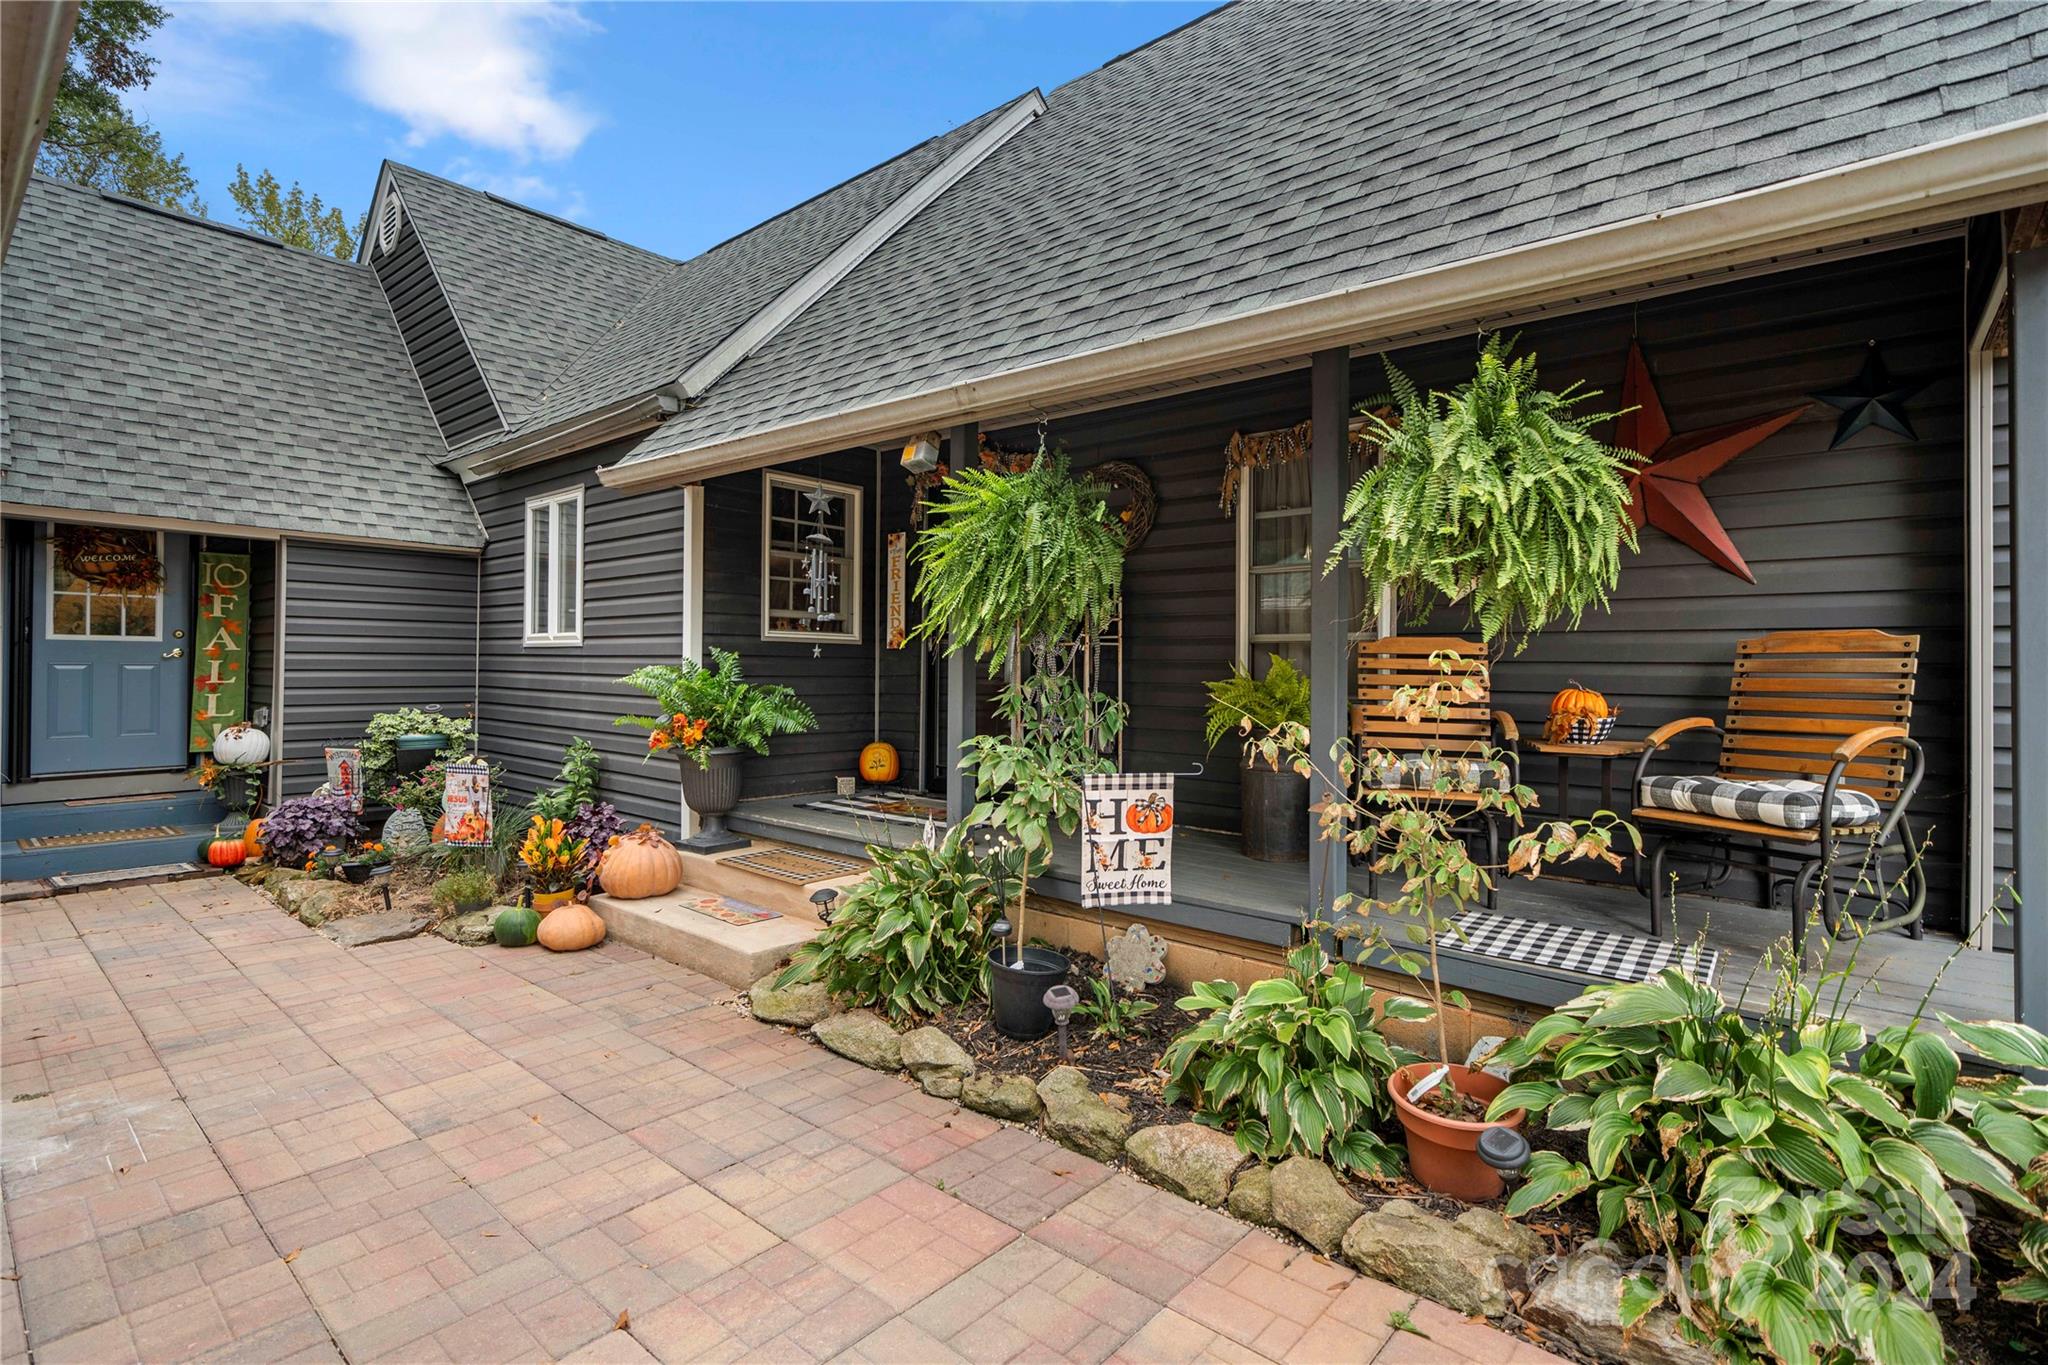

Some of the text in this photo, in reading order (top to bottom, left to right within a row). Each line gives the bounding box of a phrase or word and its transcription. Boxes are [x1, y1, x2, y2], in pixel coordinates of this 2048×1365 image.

[80, 554, 137, 562] WELCOME
[1086, 874, 1168, 892] Sweet Home
